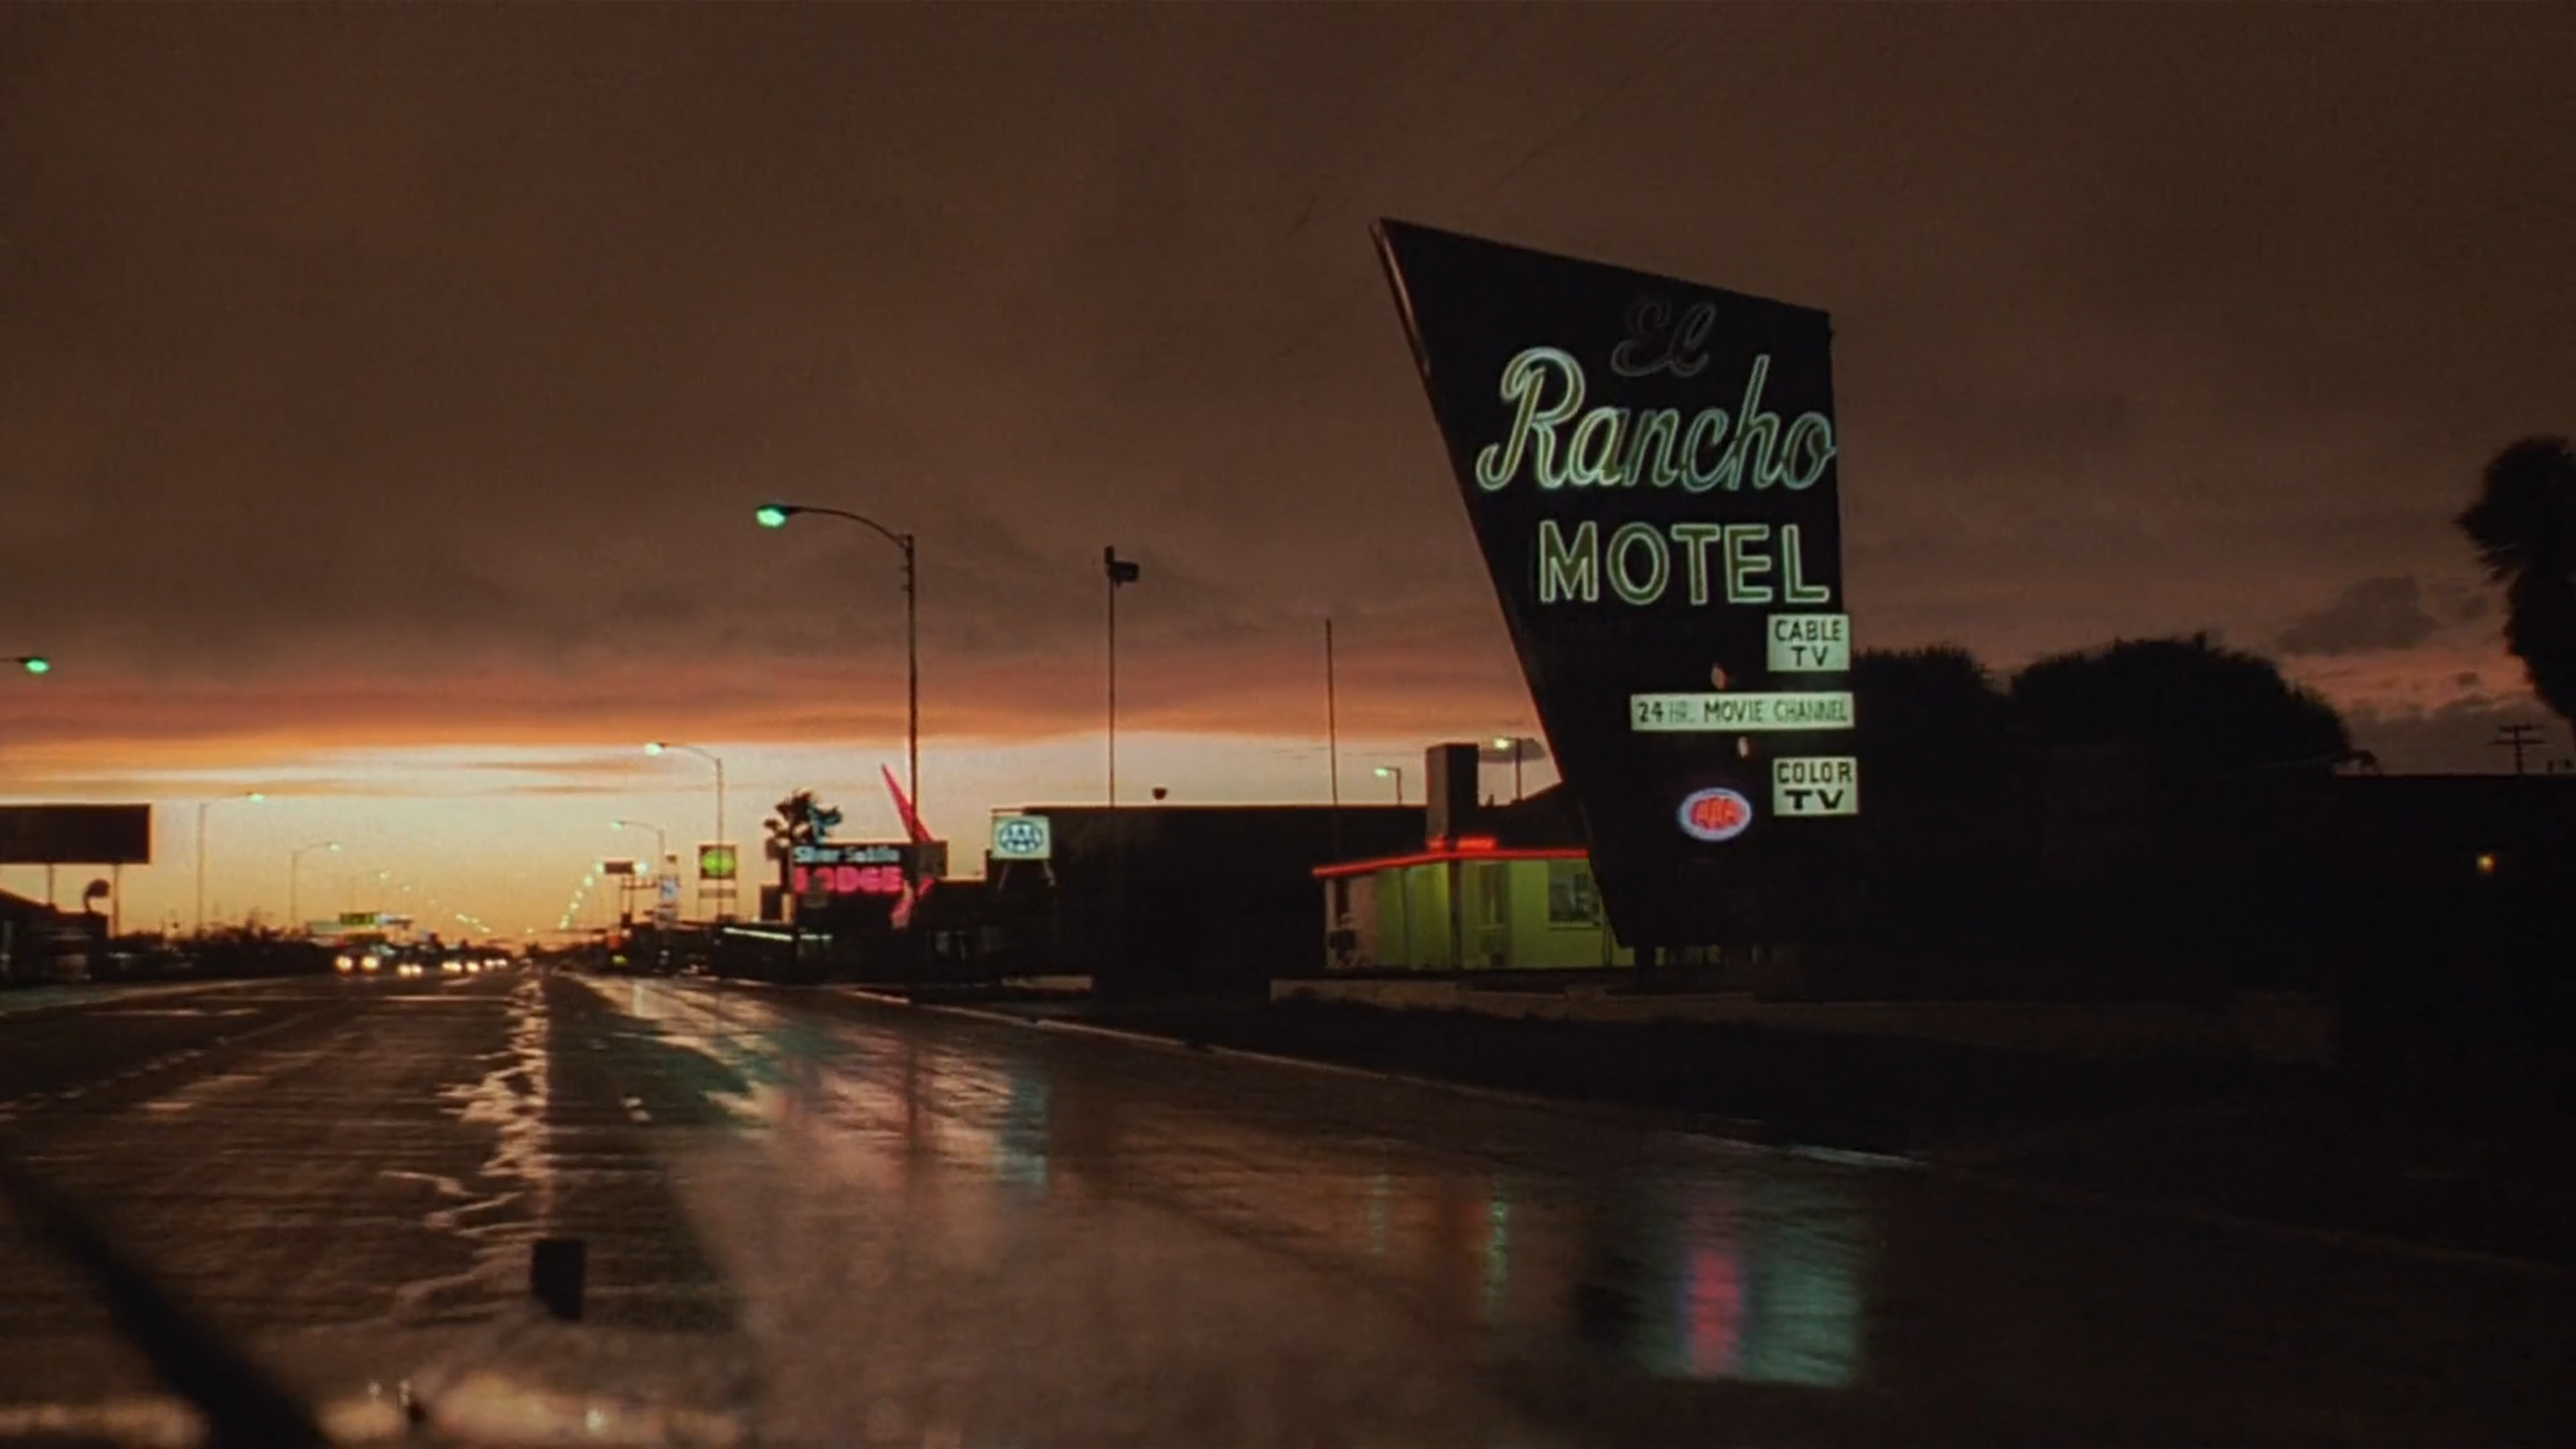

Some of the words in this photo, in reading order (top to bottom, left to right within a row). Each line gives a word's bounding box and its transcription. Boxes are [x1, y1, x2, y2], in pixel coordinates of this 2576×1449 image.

[1610, 294, 1716, 378] El
[1476, 347, 1836, 490] Rancho
[1540, 520, 1830, 604] MOTEL
[1775, 619, 1842, 641] CABLE
[1790, 646, 1828, 667] TV
[1638, 701, 1663, 724] 24
[1704, 699, 1763, 722] MOVIE
[1774, 697, 1848, 721] CHANNEL
[1777, 761, 1852, 784] COLOR
[1785, 789, 1844, 810] TV
